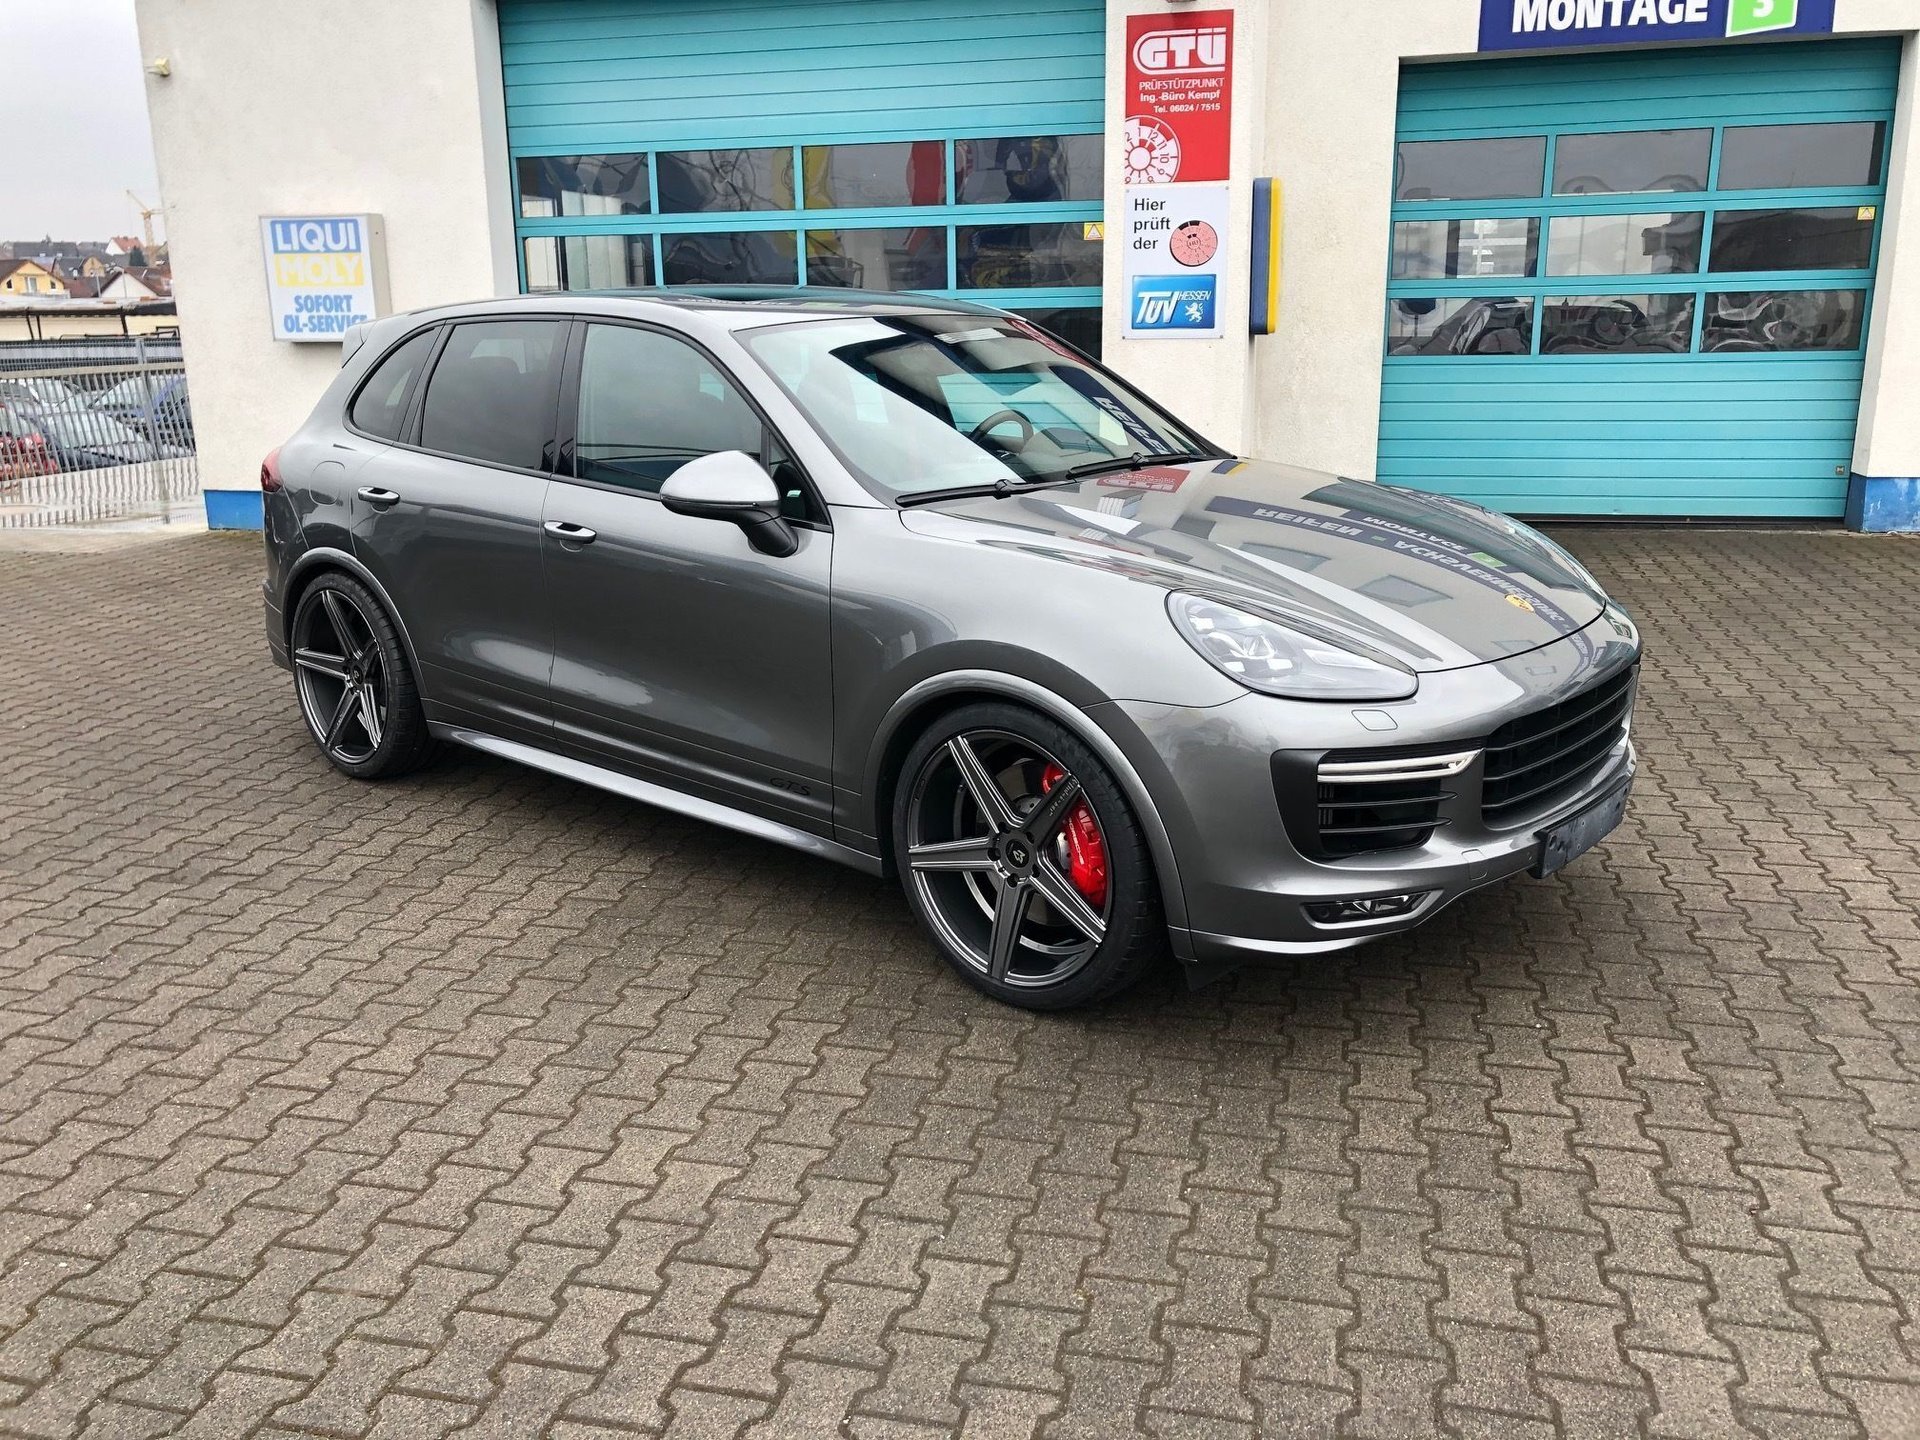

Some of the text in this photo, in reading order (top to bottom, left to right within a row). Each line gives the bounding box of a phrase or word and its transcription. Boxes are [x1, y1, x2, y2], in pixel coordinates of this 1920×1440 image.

[1512, 0, 1708, 32] MONTAGE
[1135, 27, 1226, 73] GTÜ
[1139, 78, 1225, 91] PRÜFSTÜTZPUNKT
[1140, 89, 1221, 104] Ing.-Büro Kempf
[1153, 105, 1168, 113] Tel.
[1170, 104, 1194, 112] 06024
[1201, 103, 1221, 111] 7515
[1134, 198, 1166, 212] Hier
[1133, 216, 1170, 233] prüft
[275, 222, 357, 252] LIQUI
[1133, 236, 1159, 250] der
[280, 254, 362, 284] MOLY
[294, 294, 353, 313] SOFORT
[1136, 290, 1211, 324] TÜV HESSEN
[770, 777, 811, 796] GTS
